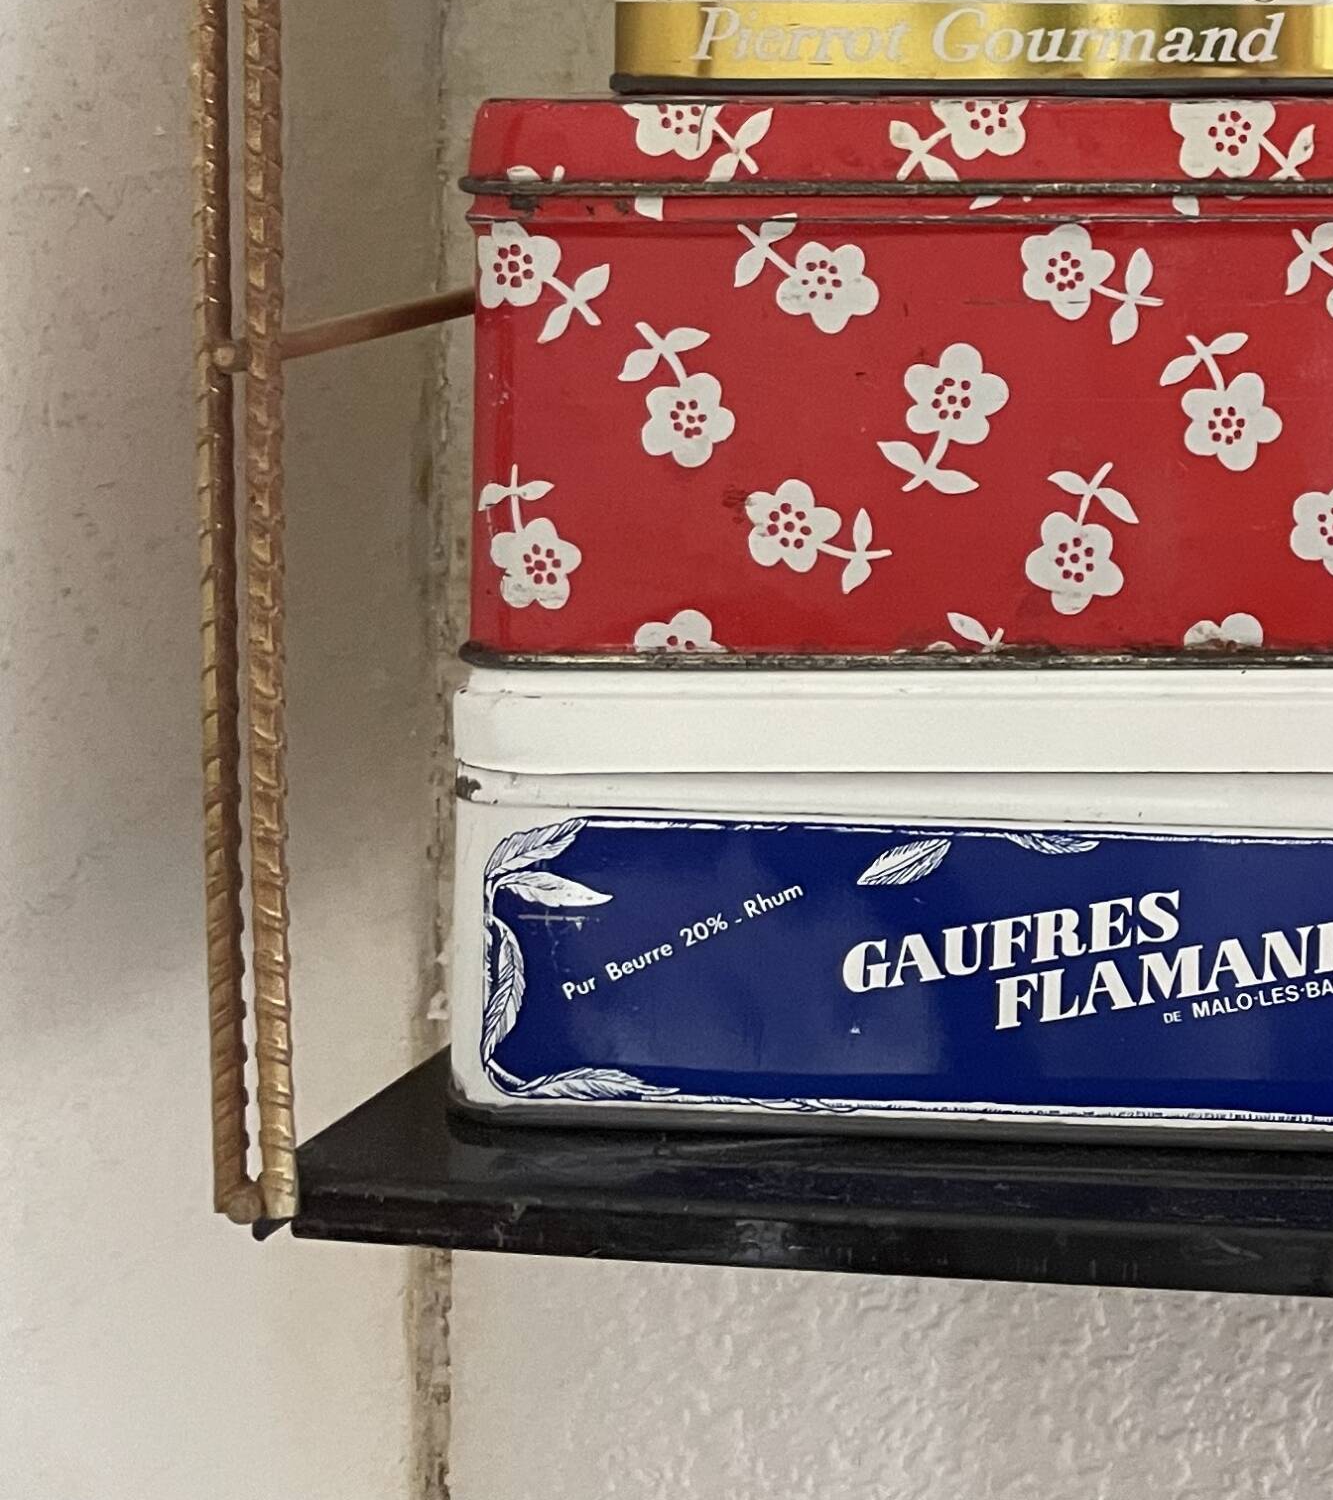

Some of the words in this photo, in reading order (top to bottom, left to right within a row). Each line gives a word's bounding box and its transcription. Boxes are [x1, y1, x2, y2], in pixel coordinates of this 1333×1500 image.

[690, 5, 910, 64] Pierrot
[932, 8, 1287, 66] Gourmand
[561, 977, 596, 1000] Pur
[604, 943, 673, 981] Beurre
[679, 912, 729, 947] 20%
[743, 885, 804, 918] Rhum
[842, 889, 1181, 993] GAUFRES
[1163, 1010, 1182, 1024] DE
